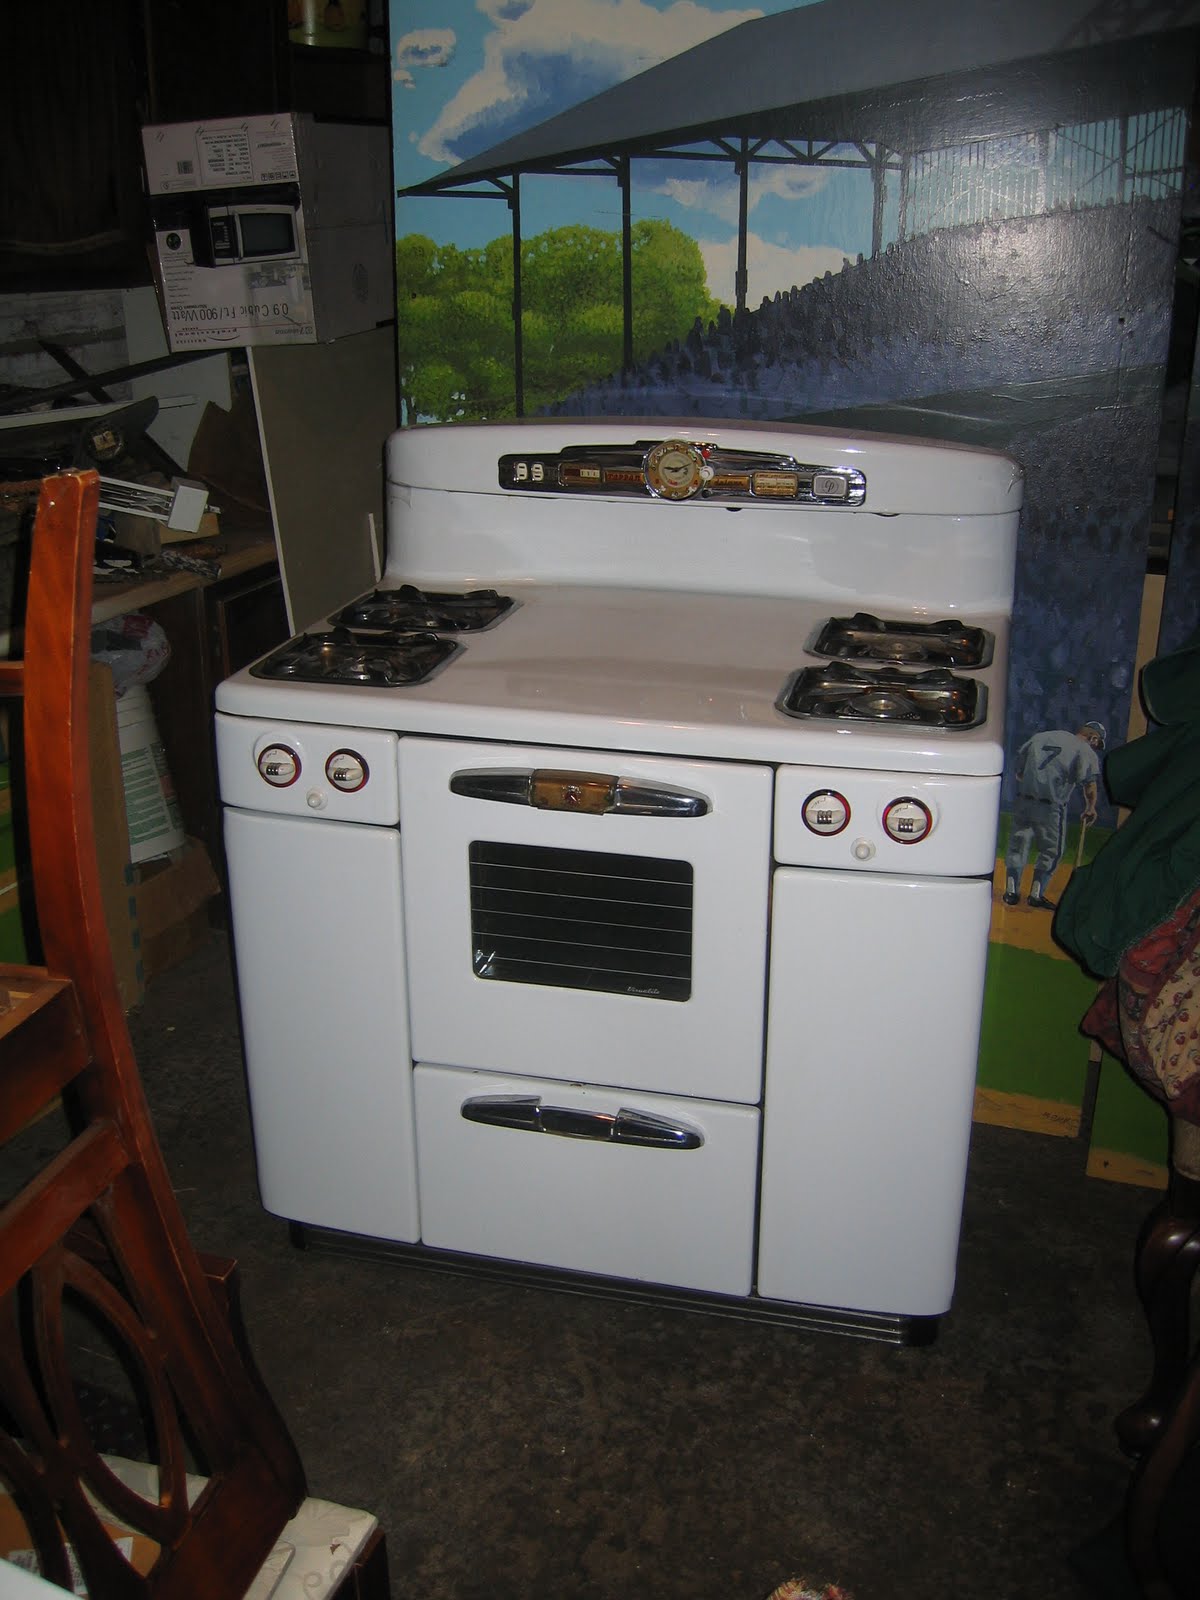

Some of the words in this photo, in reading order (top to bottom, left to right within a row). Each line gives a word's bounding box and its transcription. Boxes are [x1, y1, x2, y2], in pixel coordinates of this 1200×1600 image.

[171, 310, 199, 322] Watt
[240, 304, 269, 317] Cubic
[273, 303, 289, 316] 0.9
[1038, 745, 1062, 771] 7
